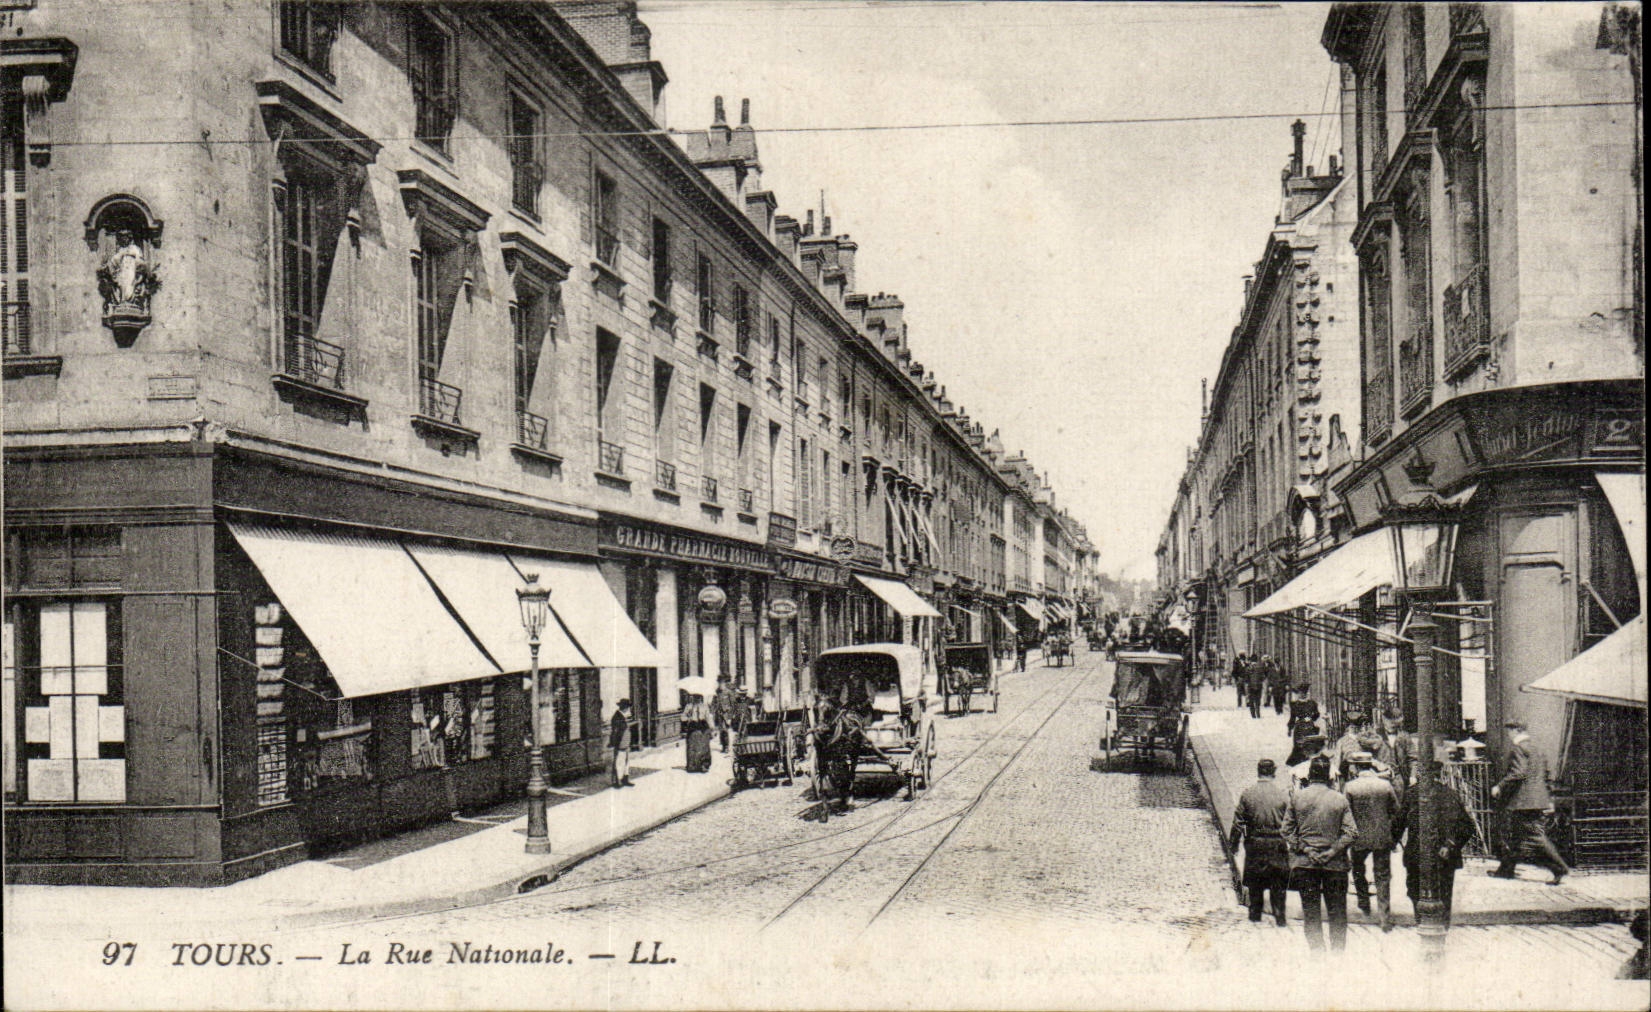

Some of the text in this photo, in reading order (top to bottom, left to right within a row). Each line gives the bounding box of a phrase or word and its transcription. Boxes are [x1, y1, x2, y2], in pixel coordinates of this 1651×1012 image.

[1606, 419, 1631, 442] 2
[616, 525, 665, 552] GRANDE
[670, 536, 726, 561] PHARMACIE
